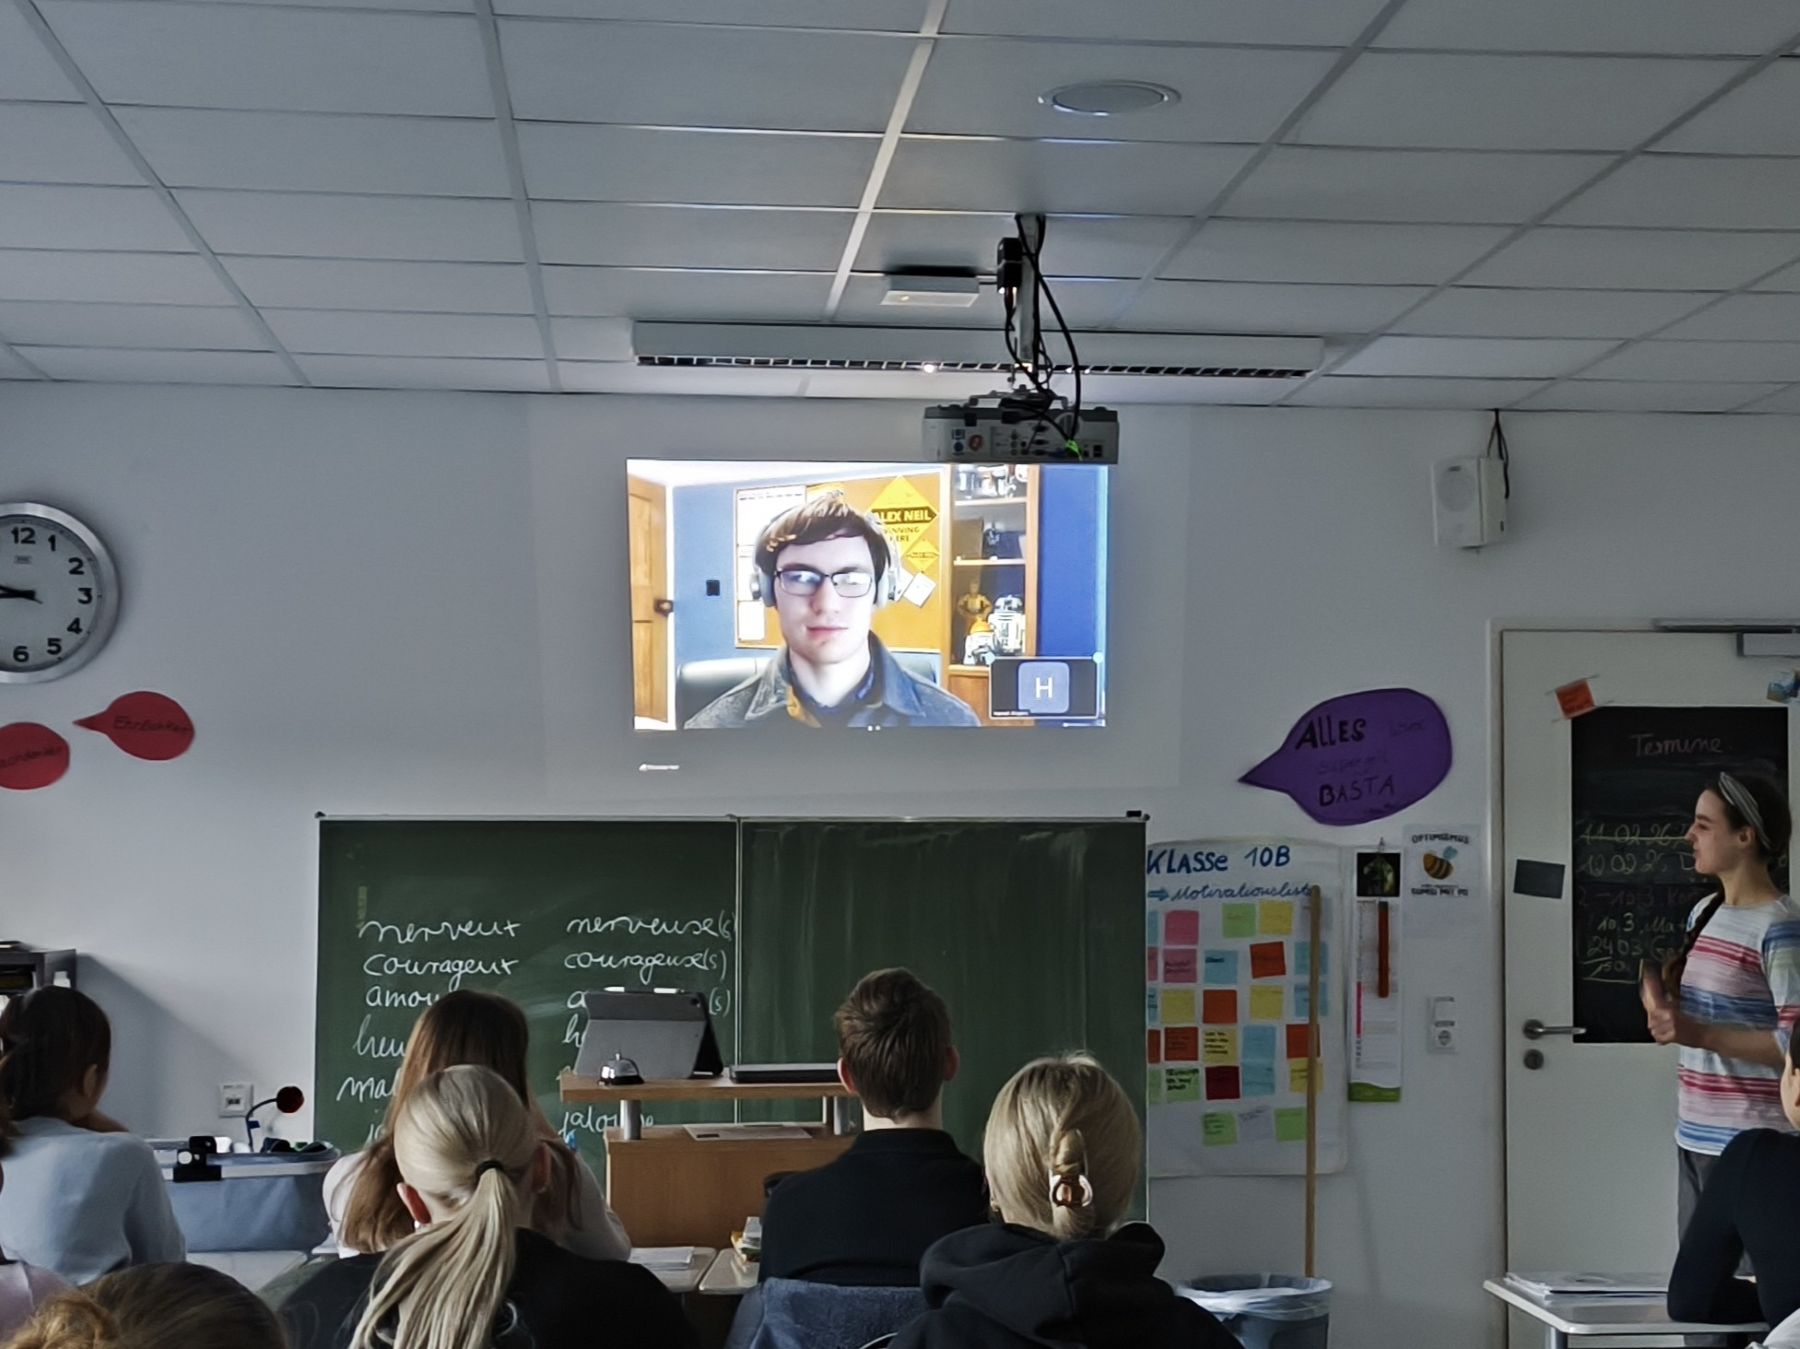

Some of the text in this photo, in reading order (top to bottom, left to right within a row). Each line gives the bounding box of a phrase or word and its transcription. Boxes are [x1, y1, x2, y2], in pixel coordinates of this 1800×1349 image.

[904, 510, 931, 521] NEIL
[11, 527, 36, 545] 12
[48, 535, 57, 552] 1
[68, 557, 85, 576] 2
[77, 587, 93, 605] 3
[67, 618, 83, 635] 4
[12, 645, 30, 664] 6
[47, 638, 63, 656] 5
[1035, 676, 1054, 700] H
[1295, 715, 1367, 750] ALLES
[1319, 775, 1396, 807] BASTA
[1244, 845, 1291, 868] 10B
